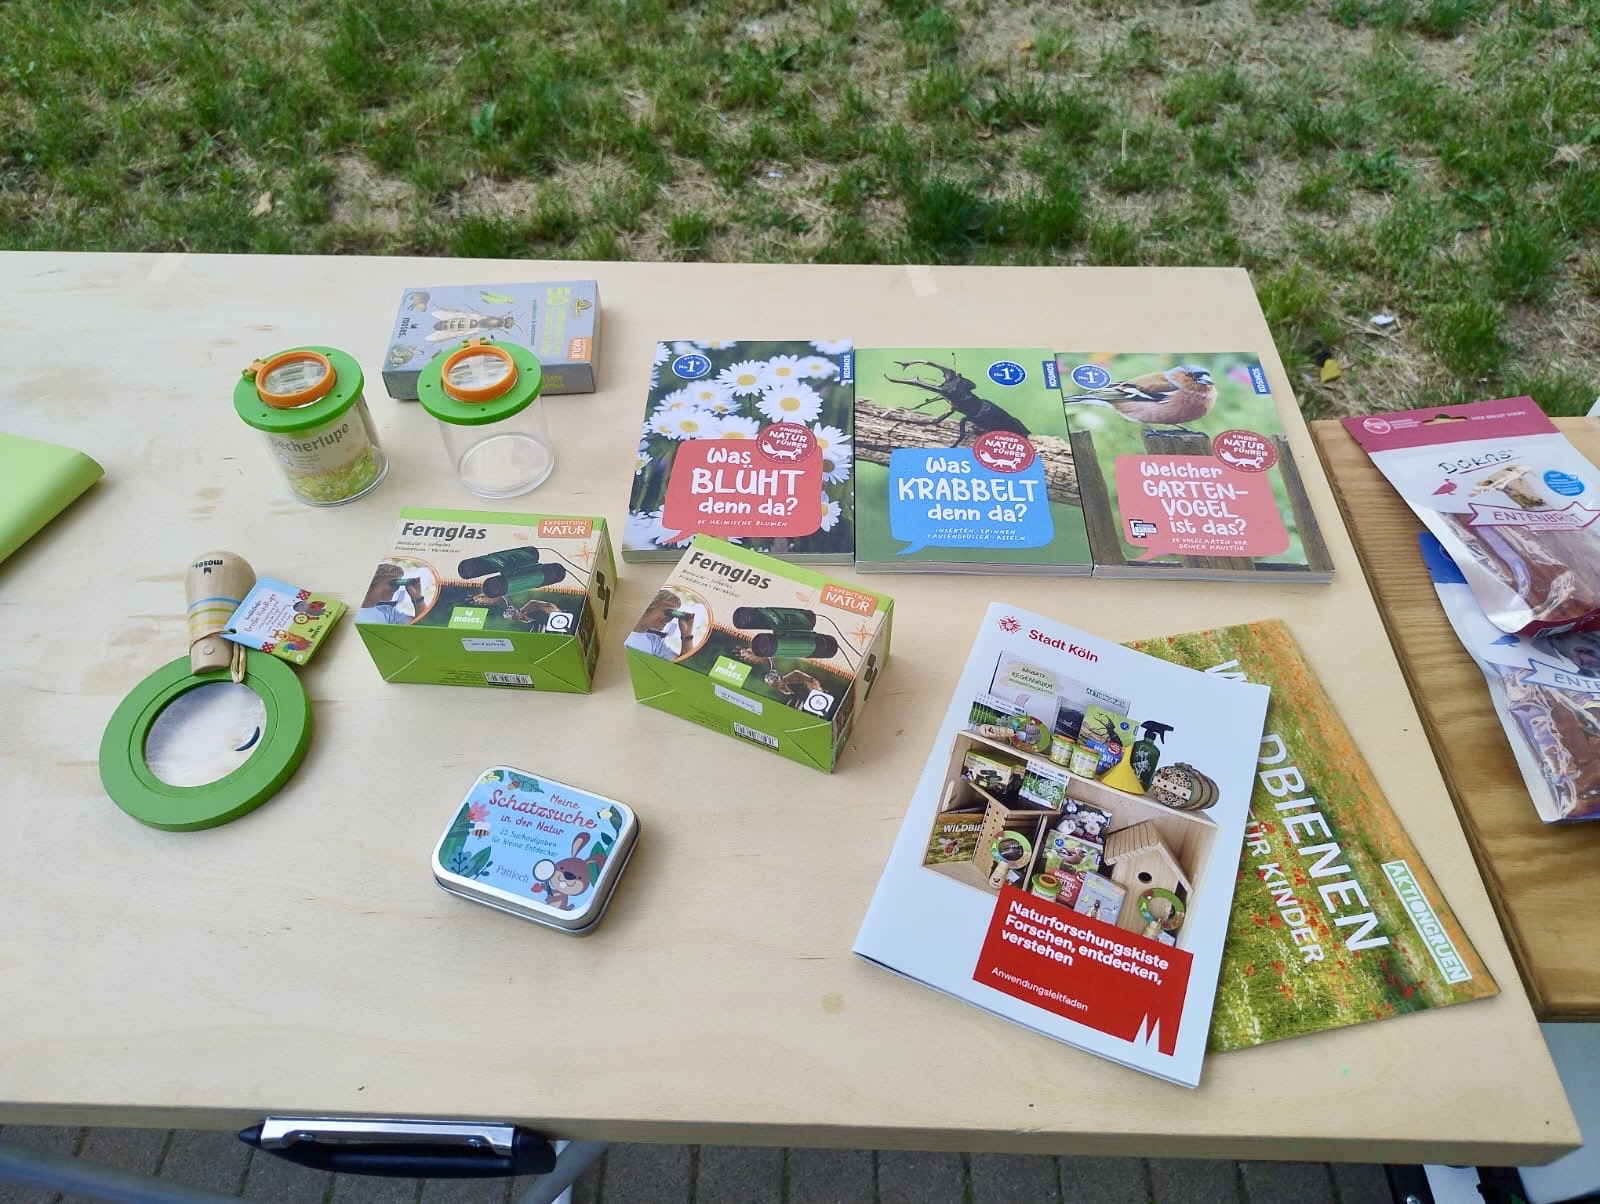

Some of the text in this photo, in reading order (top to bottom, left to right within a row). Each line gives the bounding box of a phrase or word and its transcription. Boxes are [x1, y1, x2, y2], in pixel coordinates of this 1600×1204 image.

[769, 431, 808, 443] NATUR
[776, 439, 808, 449] FÜHRER
[985, 439, 1025, 451] NATUR
[1223, 438, 1264, 451] NATUR
[1232, 433, 1258, 441] KINDER
[706, 447, 751, 464] Was
[993, 447, 1026, 459] FÜHRER
[1233, 446, 1268, 457] FÜHRER
[925, 456, 971, 474] Was
[1140, 461, 1222, 479] Welcher
[690, 464, 806, 496] BLÜHT
[1143, 479, 1249, 500] GARTEN-
[897, 477, 1039, 503] KRABBELT
[698, 497, 799, 516] denn da?
[927, 503, 1028, 522] denn da?
[1160, 498, 1240, 518] VOGEL
[401, 522, 487, 541] Fernglas
[543, 525, 586, 535] NATUR
[1168, 518, 1197, 534] ist
[1202, 518, 1247, 536] das?
[689, 551, 772, 590] Fernglas
[825, 591, 870, 612] NATUR
[829, 586, 873, 602] EXPEDITION
[1028, 629, 1099, 663] Stadt Köln
[489, 789, 598, 829] Schatzsuche
[549, 794, 581, 810] Meine
[500, 815, 565, 836] in der Natur
[510, 830, 558, 848] Suchaufgaben
[524, 844, 559, 858] Entdecker
[496, 864, 530, 883] Pattloch
[1260, 862, 1327, 965] KINDER
[1384, 862, 1470, 983] AKTIONGRUEN
[1009, 899, 1169, 970] Naturforschungskiste
[1001, 929, 1074, 966] verstehen
[1004, 914, 1164, 985] Forschen, entdecken,
[991, 966, 1089, 1012] Anwendungsleitfaden
